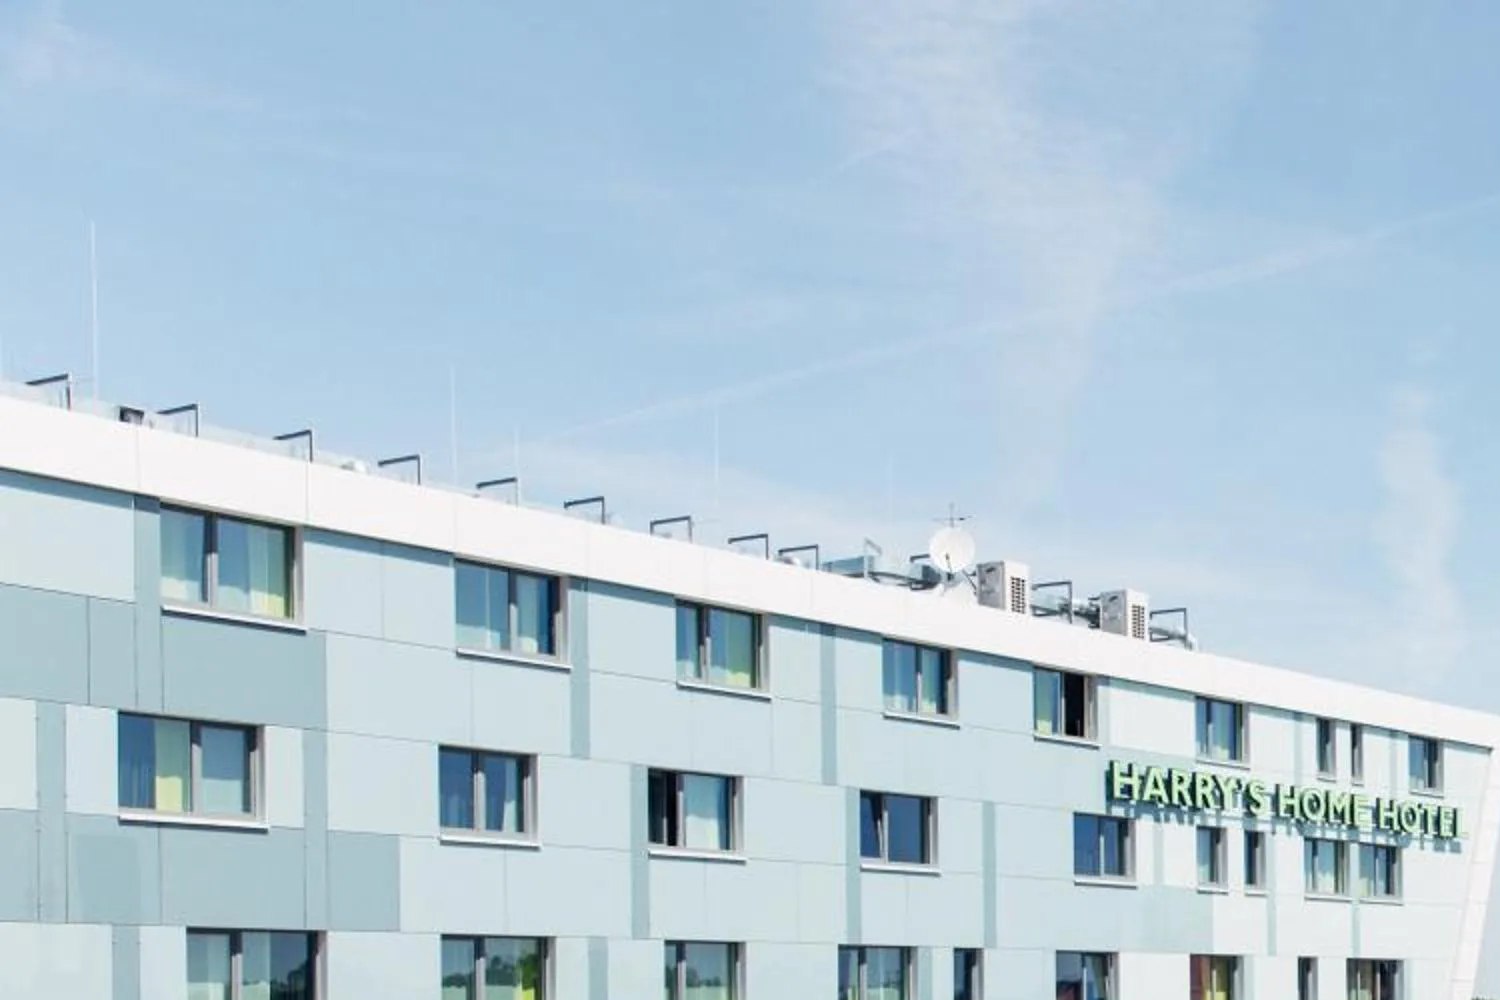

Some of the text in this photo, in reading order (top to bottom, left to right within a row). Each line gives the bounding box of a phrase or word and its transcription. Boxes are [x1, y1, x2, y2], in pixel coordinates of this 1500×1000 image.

[1109, 759, 1470, 839] HARRY'S HOME HOTEL
